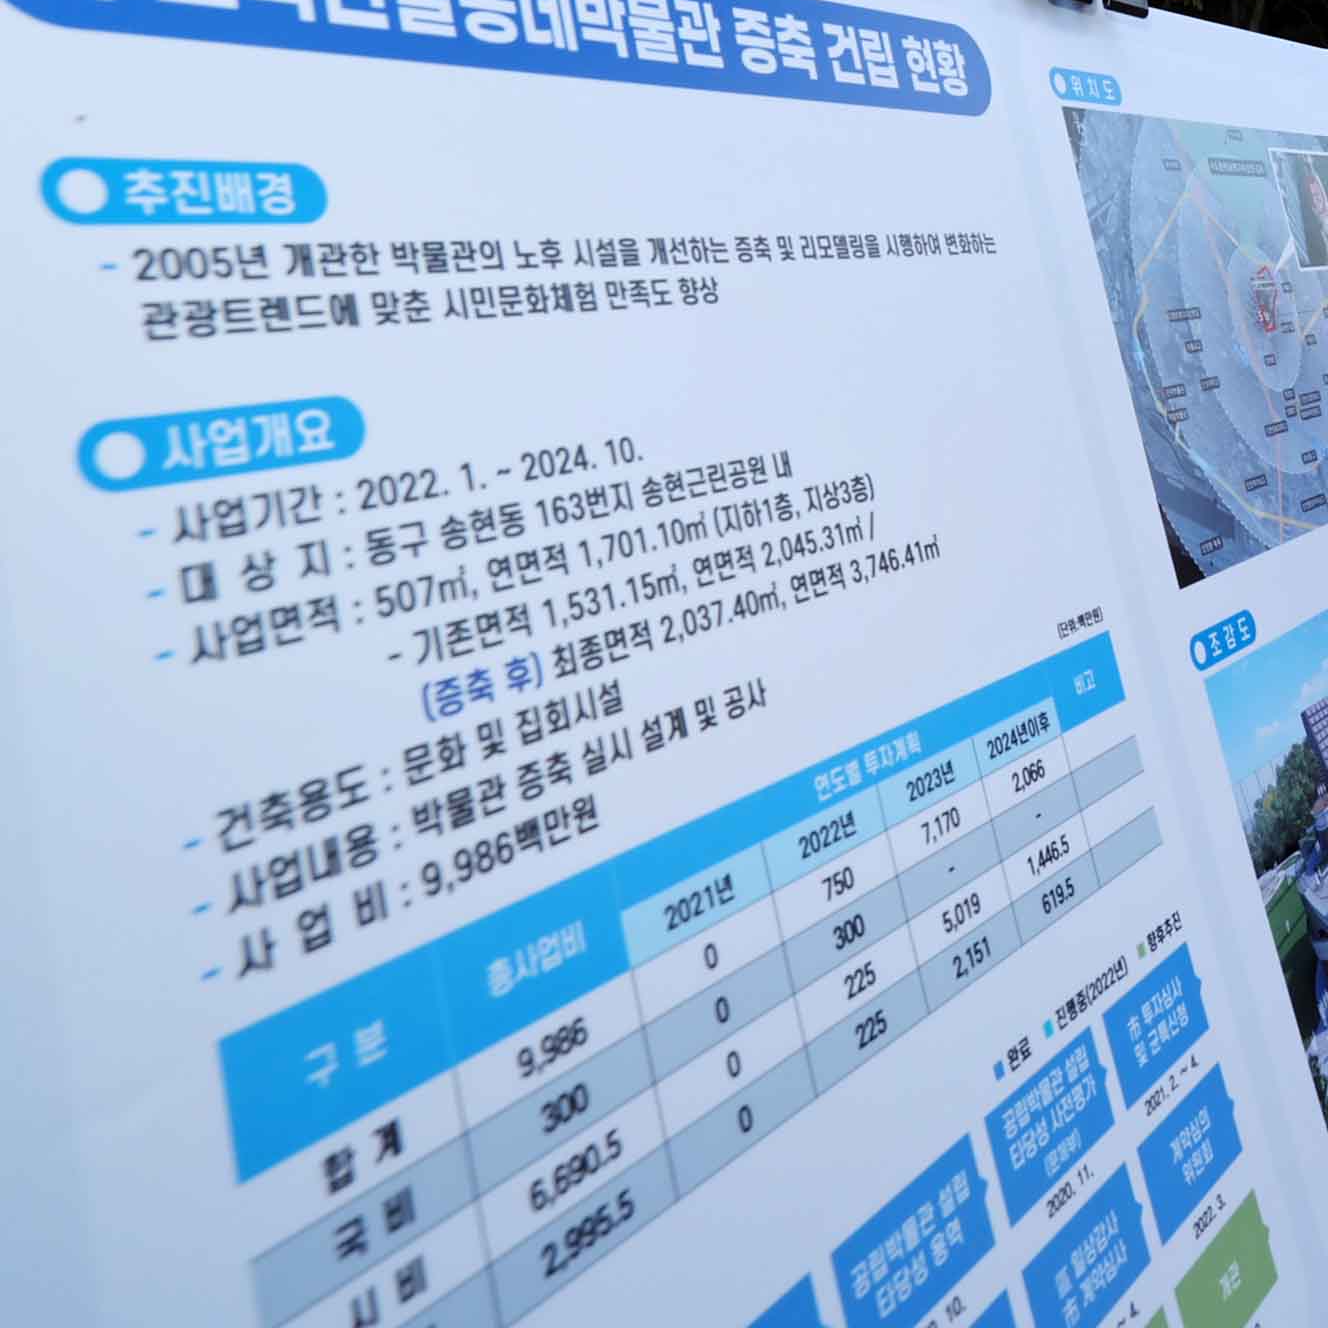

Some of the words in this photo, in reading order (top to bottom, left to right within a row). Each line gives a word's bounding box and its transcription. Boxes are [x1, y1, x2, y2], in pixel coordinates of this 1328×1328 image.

[731, 6, 817, 81] 증축
[822, 22, 900, 90] 건립
[901, 34, 969, 98] 현황
[124, 170, 296, 216] 추진배경
[132, 244, 269, 281] 2005년
[283, 241, 380, 278] 개관한
[391, 239, 505, 274] 박물관의
[512, 238, 563, 271] 노후
[573, 237, 641, 269] 시설을
[647, 235, 730, 266] 개선하는
[734, 235, 773, 264] 증축
[778, 235, 797, 263] 및
[800, 234, 880, 261] 리모델링을
[886, 233, 942, 259] 시행하여
[944, 232, 997, 256] 변화하는
[143, 294, 361, 342] 관광트렌드에
[371, 289, 432, 328] 맞춘
[443, 279, 598, 321] 시민문화체험
[604, 278, 674, 311] 만족도
[678, 275, 720, 306] 향상
[162, 409, 335, 472] 사업개요
[172, 484, 322, 544] 사업기간
[357, 468, 450, 512] 2022.
[460, 463, 488, 490] 1.
[521, 445, 597, 482] 2024.
[605, 436, 644, 465] 10.
[366, 523, 429, 567] 동구
[440, 502, 526, 553] 송현동
[537, 482, 634, 528] 163번지
[641, 453, 768, 507] 송현근린공원
[772, 450, 793, 478] 내
[189, 594, 342, 665] 사업면적
[486, 542, 570, 592] 연면적
[713, 492, 800, 538] (지하1층,
[805, 473, 876, 514] 지상3층)
[413, 602, 533, 665] 기존면적
[692, 544, 757, 590] 연면적
[421, 666, 495, 722] (증축
[505, 650, 543, 693] 후)
[552, 622, 653, 681] 최종면적
[790, 560, 848, 604] 연면적
[986, 710, 1051, 760] 2024년이후
[216, 763, 371, 853] 건축용도
[403, 730, 467, 786] 문화
[477, 716, 506, 760] 및
[516, 679, 625, 747] 집회시설
[906, 759, 957, 804] 2023년
[1011, 759, 1047, 794] 2,066
[228, 823, 380, 915] 사업내용
[411, 773, 507, 839] 박물관
[516, 751, 573, 803] 증축
[582, 724, 633, 776] 실시
[641, 708, 688, 754] 설계
[694, 695, 718, 732] 및
[723, 677, 768, 720] 공사
[420, 794, 601, 898] 9,986백만원
[798, 811, 858, 860] 2022년
[921, 807, 961, 846] 7,170
[1027, 834, 1071, 876] 1,446.5
[664, 873, 735, 931] 2021년
[821, 866, 856, 903] 750
[1041, 877, 1076, 916] 619.5
[833, 913, 866, 950] 300
[941, 892, 982, 935] 5,019
[704, 943, 718, 970] 0
[952, 935, 993, 980] 2,151
[844, 962, 876, 1001] 225
[715, 996, 730, 1024] 0
[855, 1011, 888, 1051] 225
[515, 1016, 588, 1079] 9,986
[726, 1050, 742, 1078] 0
[540, 1083, 590, 1134] 300
[737, 1104, 753, 1134] 0
